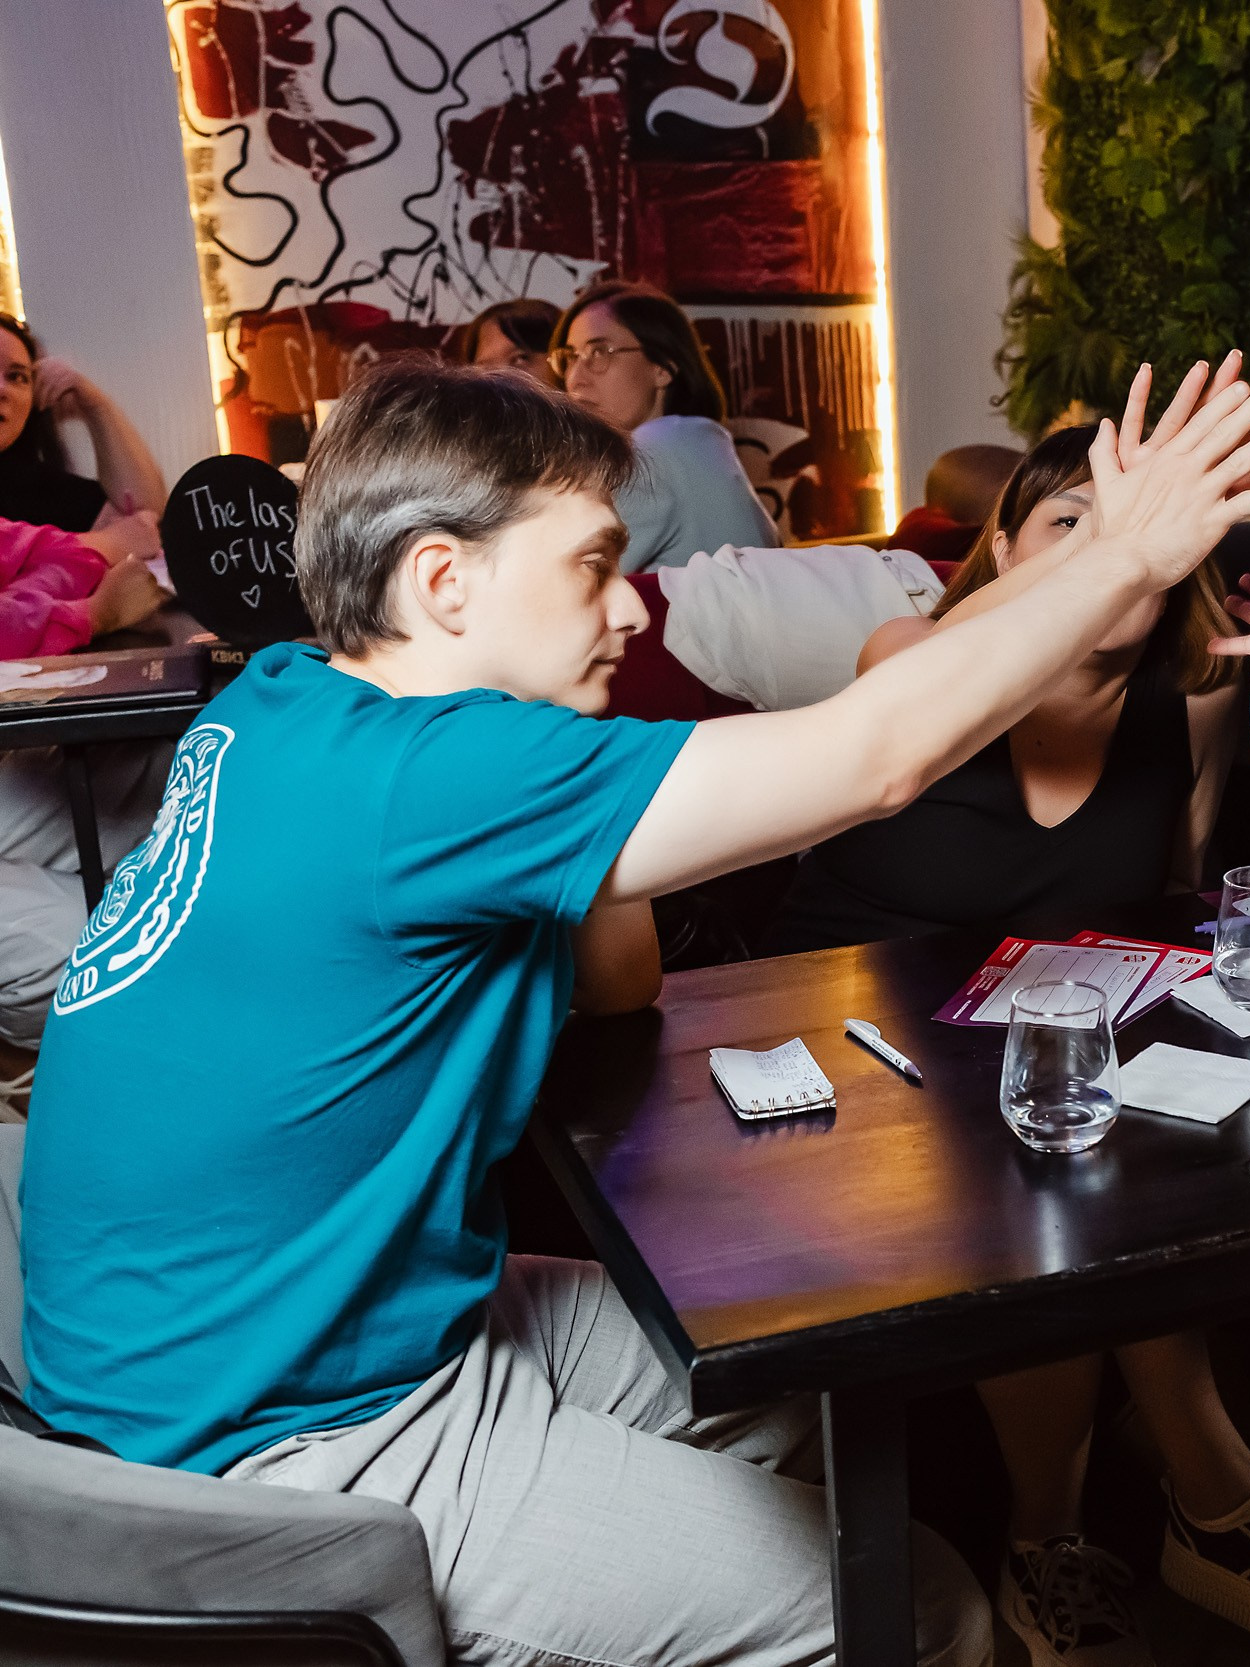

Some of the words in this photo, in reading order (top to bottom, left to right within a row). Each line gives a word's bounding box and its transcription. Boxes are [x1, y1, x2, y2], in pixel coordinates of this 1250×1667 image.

[185, 485, 245, 531] The
[248, 485, 299, 533] las
[210, 538, 243, 575] of
